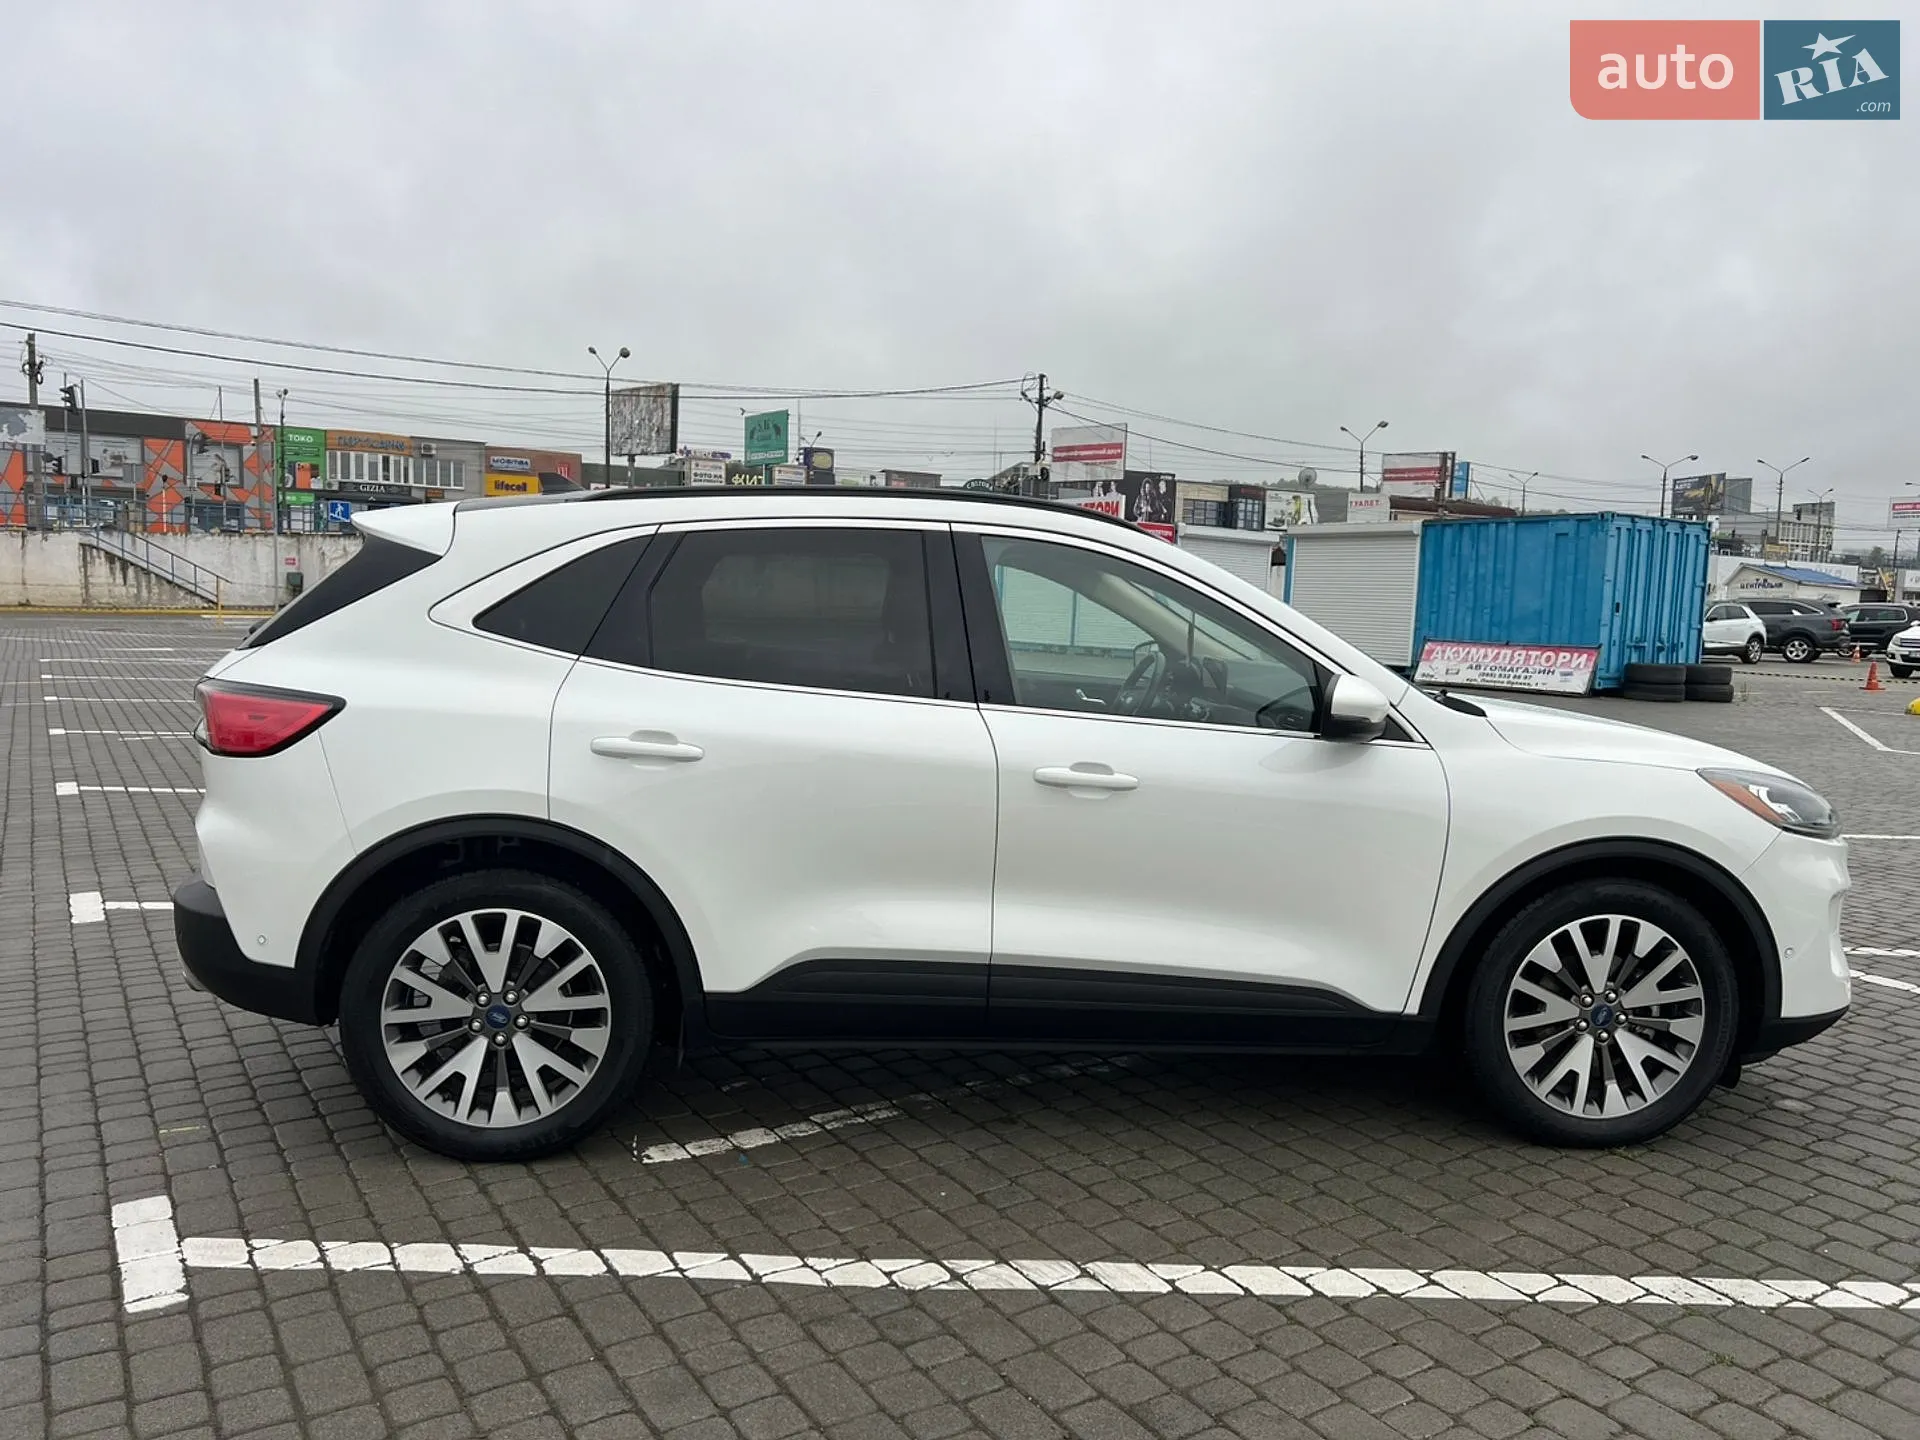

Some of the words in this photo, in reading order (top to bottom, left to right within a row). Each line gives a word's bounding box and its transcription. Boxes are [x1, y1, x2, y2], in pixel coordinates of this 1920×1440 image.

[287, 434, 314, 444] TOKO
[1430, 645, 1588, 669] АКУМУЛЯТОРИ
[1466, 664, 1556, 676] АВТОМАГАЗИН
